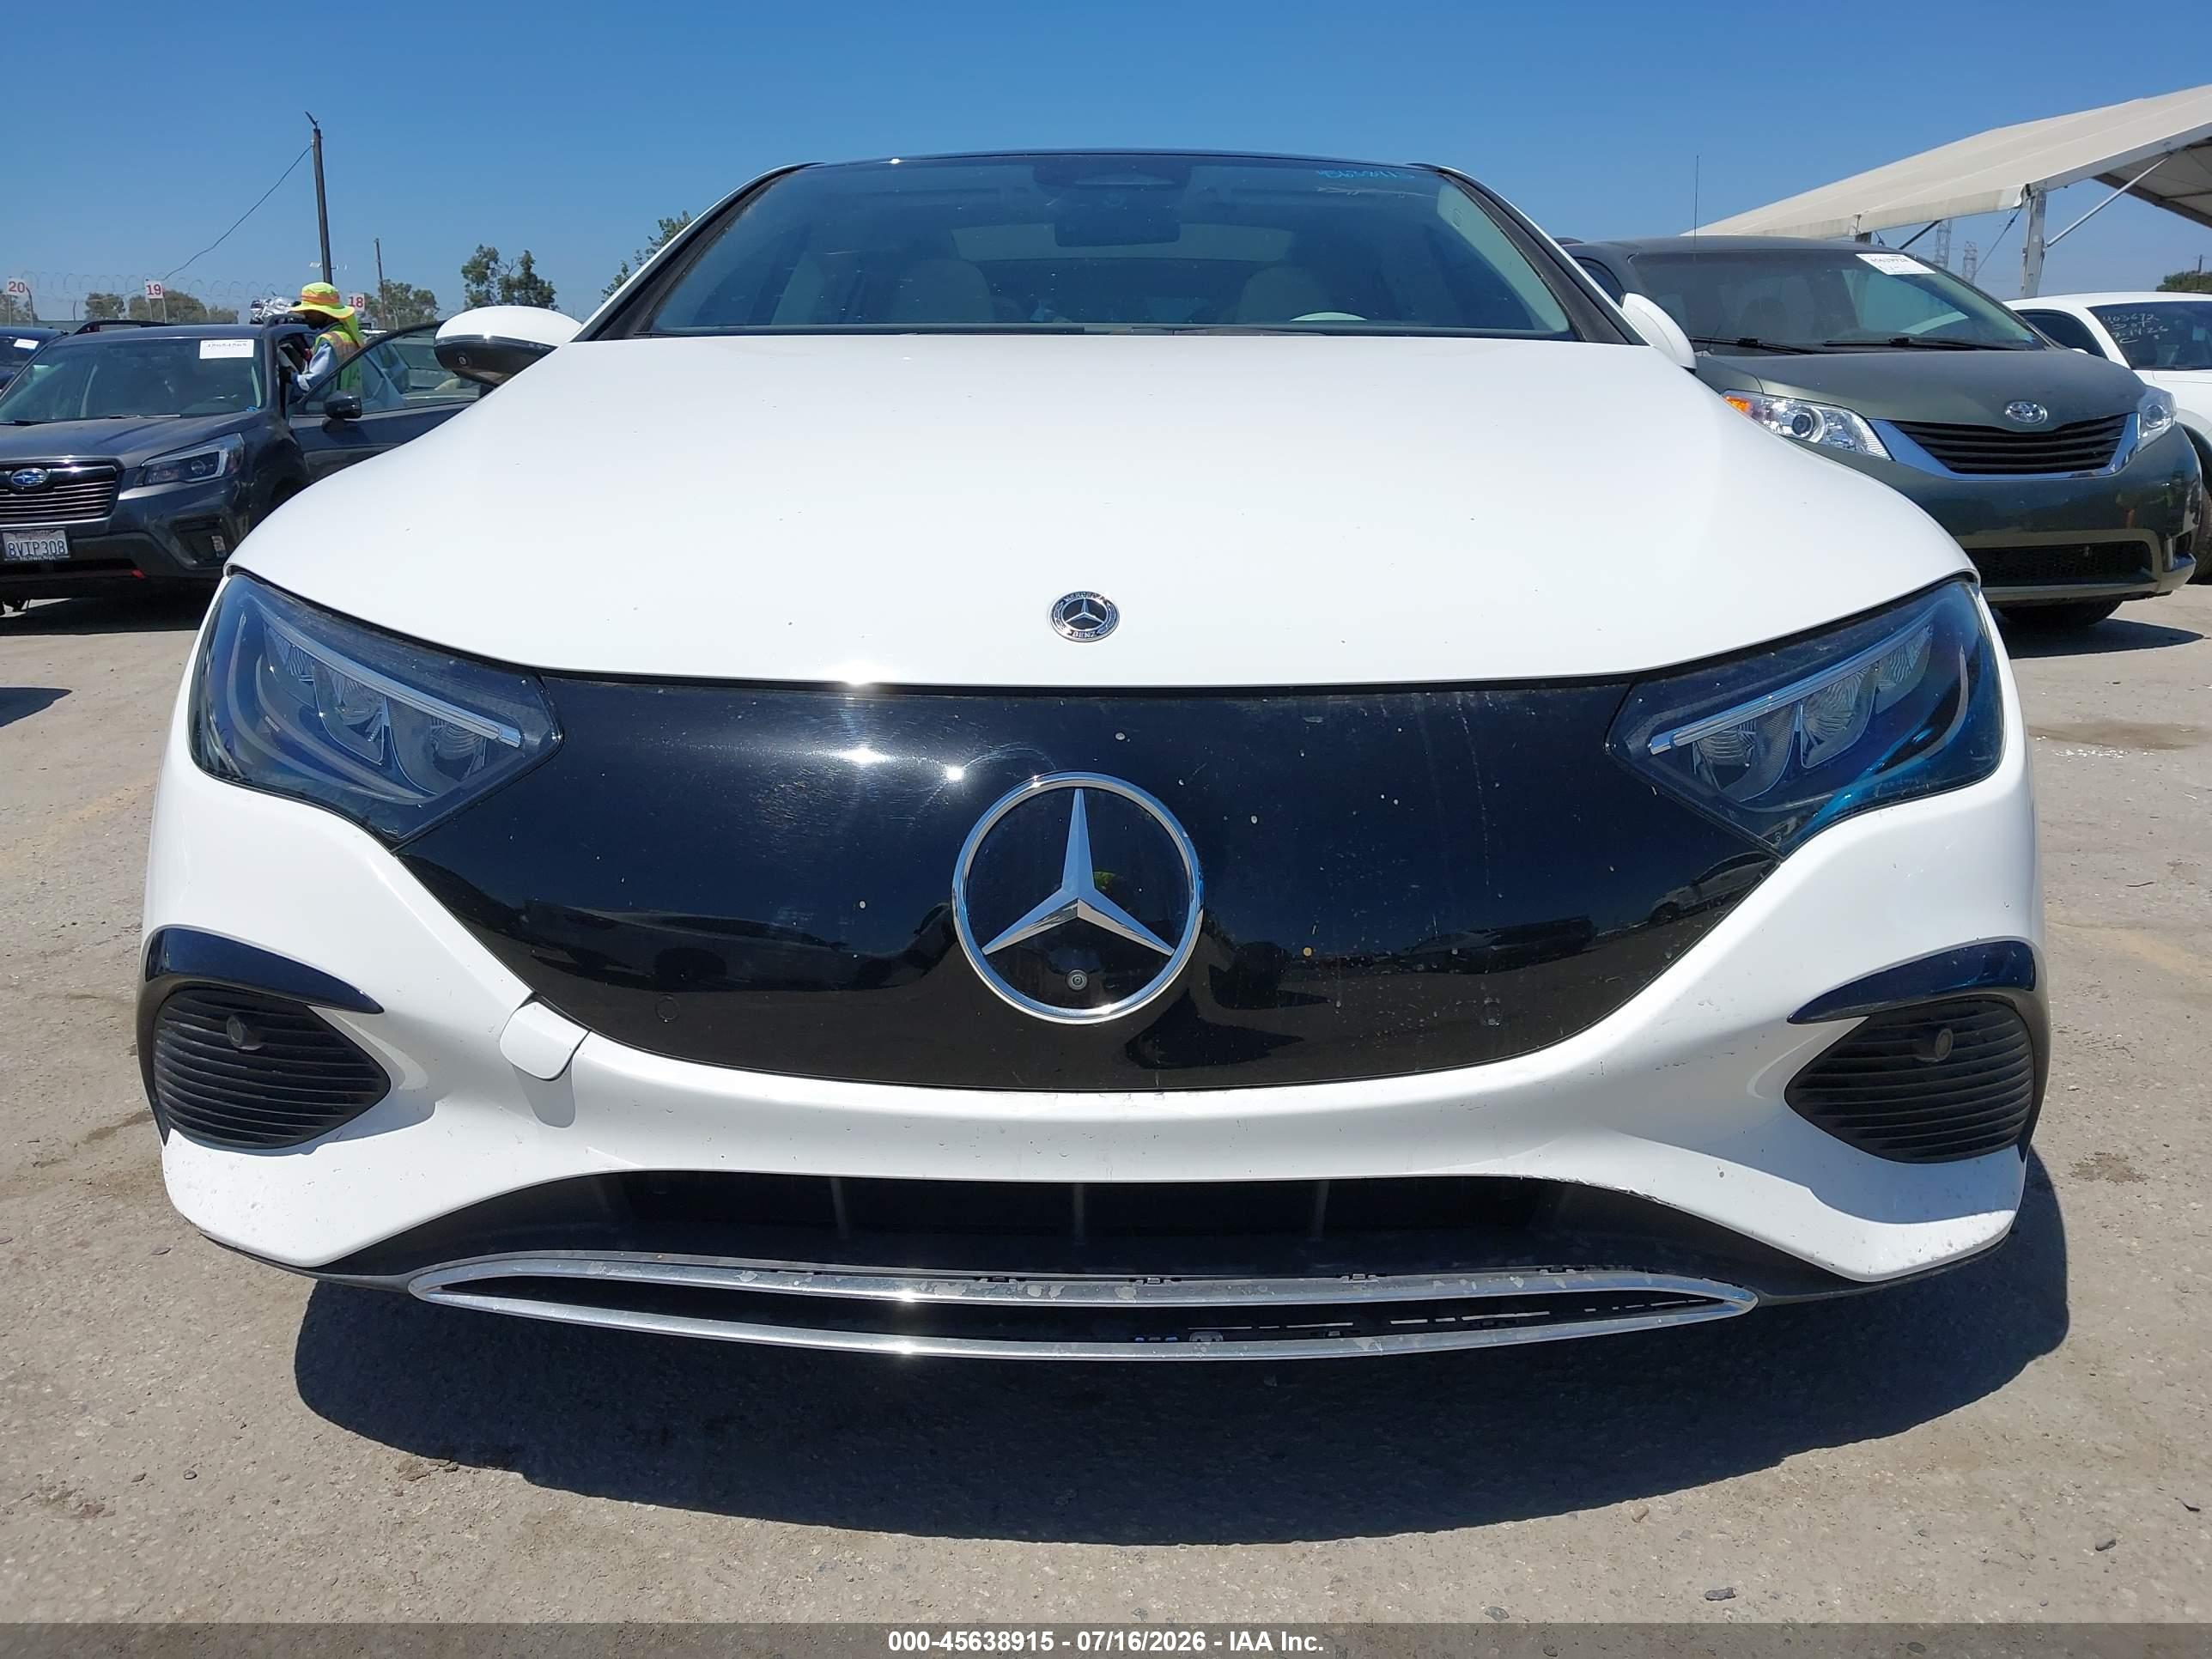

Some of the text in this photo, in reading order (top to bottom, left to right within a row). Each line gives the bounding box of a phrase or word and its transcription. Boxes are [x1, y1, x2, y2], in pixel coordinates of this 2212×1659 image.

[8, 281, 26, 293] 20
[147, 283, 161, 295] 19
[348, 296, 364, 307] 18
